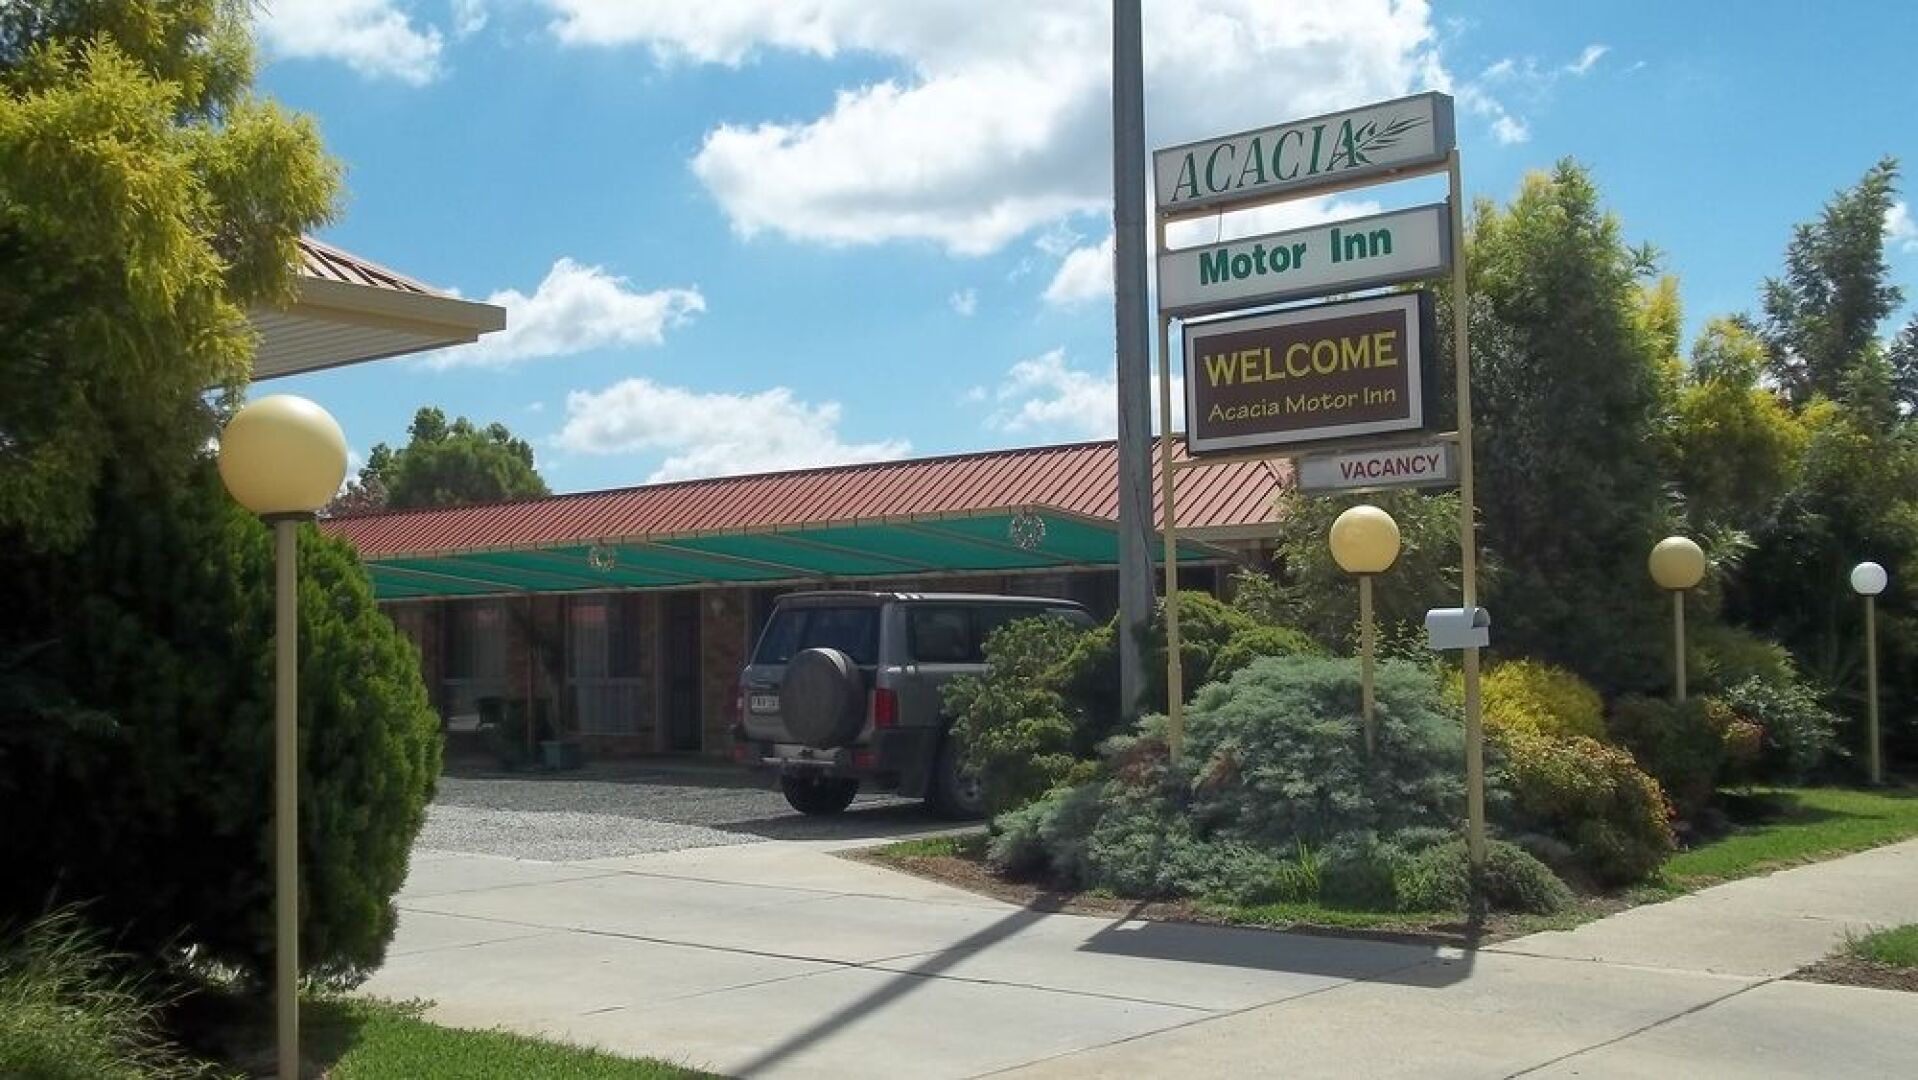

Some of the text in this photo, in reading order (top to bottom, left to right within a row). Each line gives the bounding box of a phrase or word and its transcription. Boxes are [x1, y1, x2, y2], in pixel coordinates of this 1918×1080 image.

[1171, 118, 1360, 201] ACACIA
[1200, 227, 1392, 286] Motor Inn
[1204, 330, 1398, 388] WELCOME
[1208, 386, 1397, 422] Acacia Motor Inn
[1340, 454, 1440, 481] VACANCY
